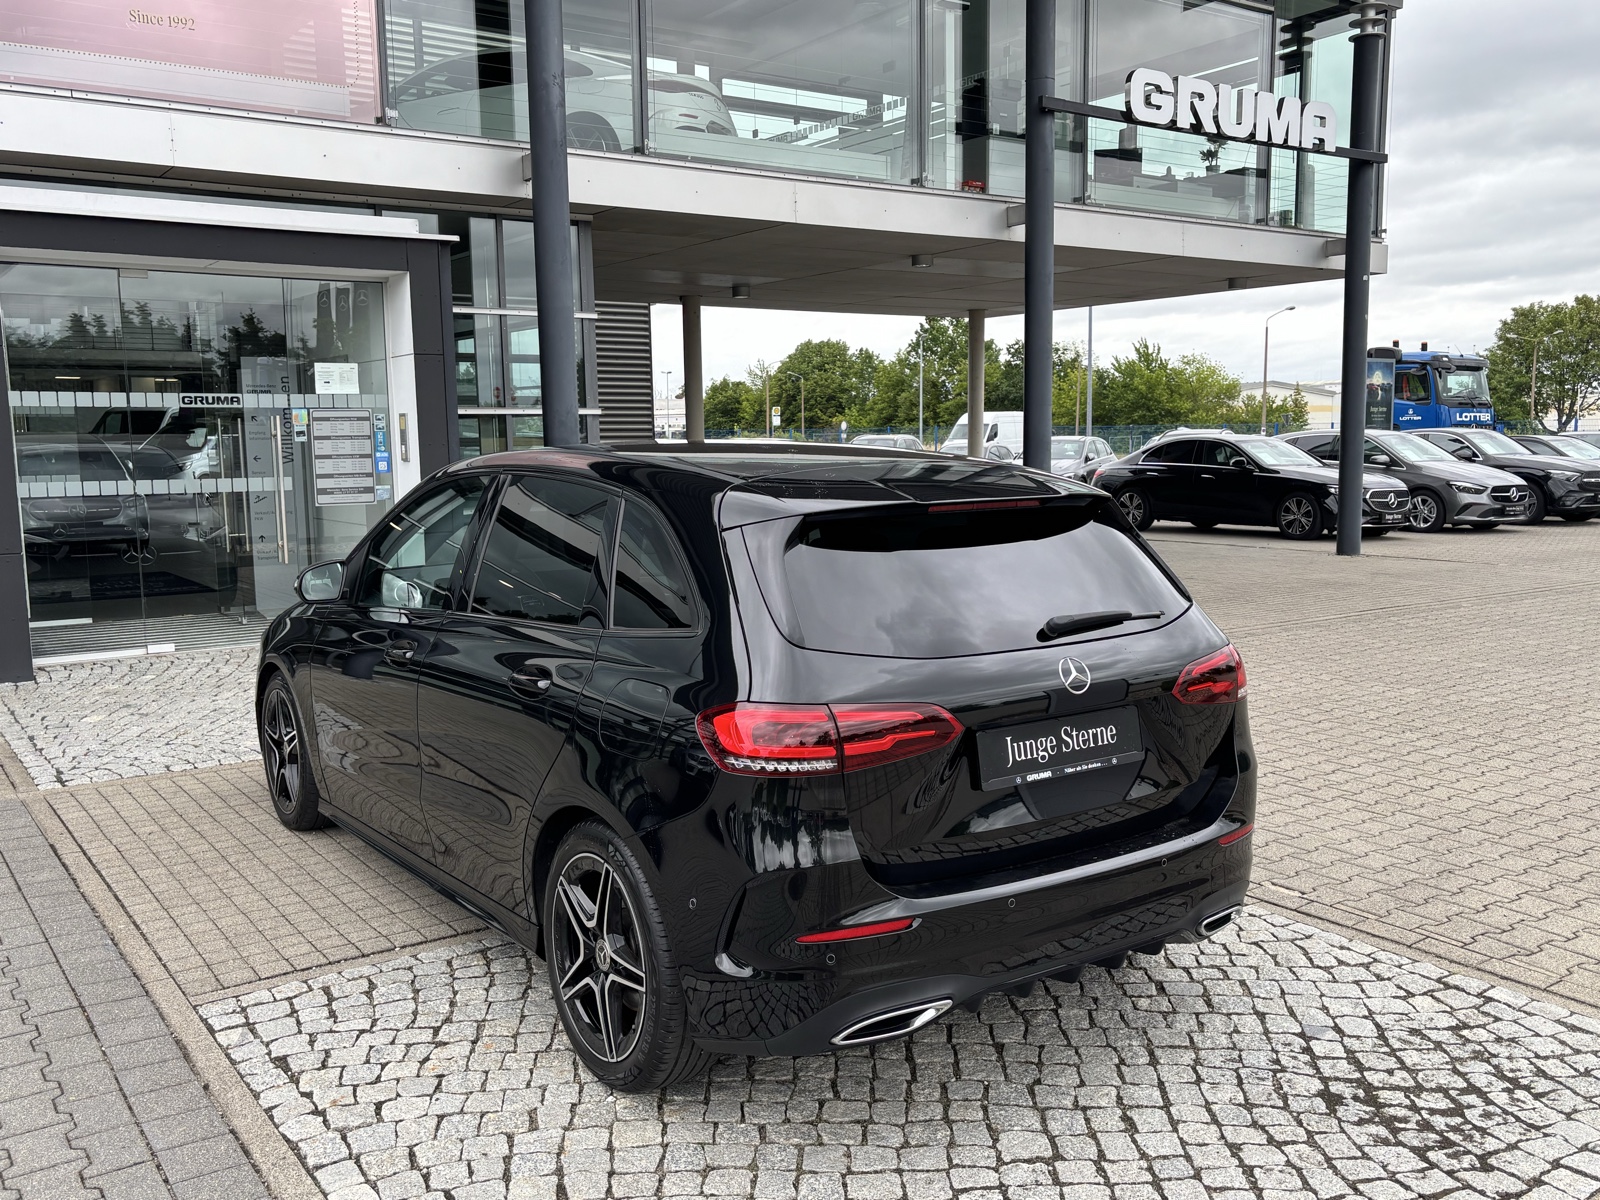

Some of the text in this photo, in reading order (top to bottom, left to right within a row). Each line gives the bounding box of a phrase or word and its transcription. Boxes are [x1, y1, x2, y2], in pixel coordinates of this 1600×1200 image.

[129, 9, 195, 31] Since 1992
[1126, 67, 1337, 152] GRUMA
[181, 395, 241, 405] GRUMA
[281, 376, 294, 464] Willkomen
[1456, 412, 1491, 421] LOTTER
[1005, 724, 1117, 768] Junge Sterne
[1026, 770, 1053, 782] GRUMA
